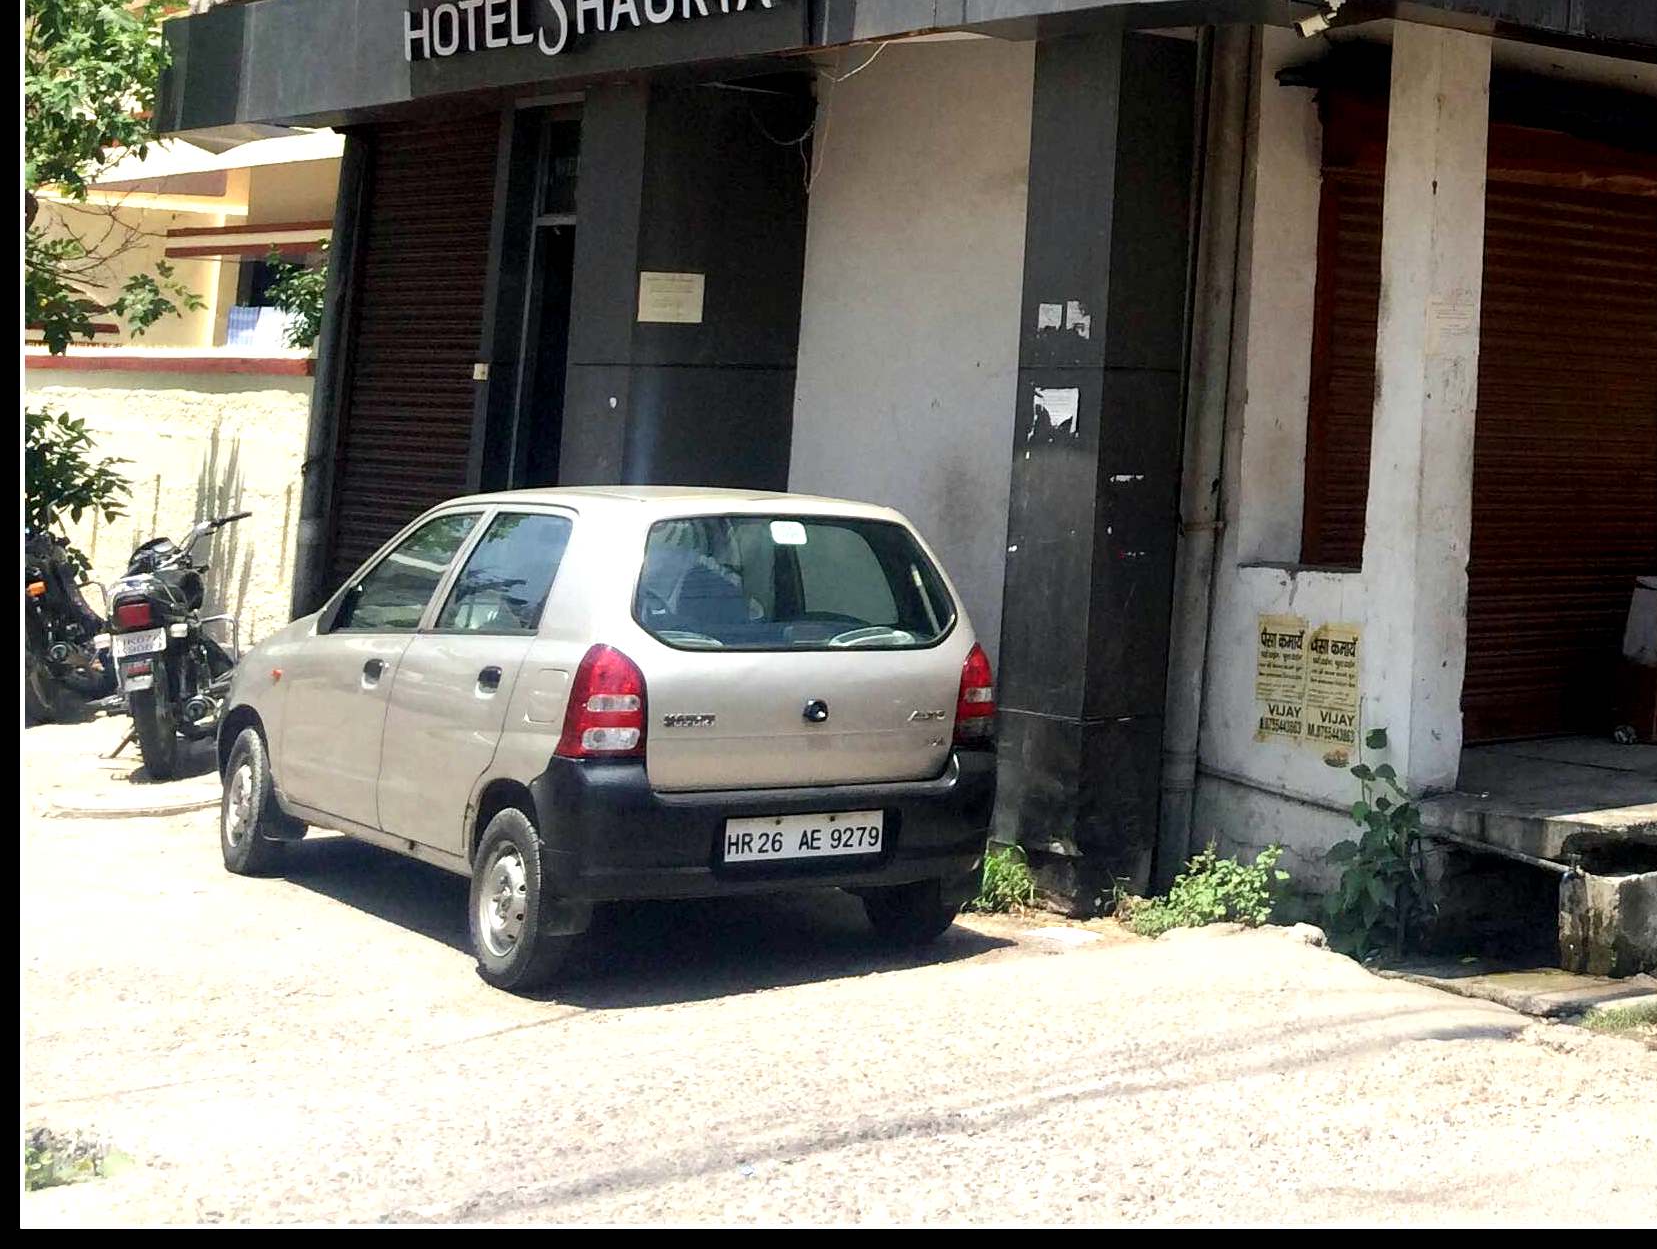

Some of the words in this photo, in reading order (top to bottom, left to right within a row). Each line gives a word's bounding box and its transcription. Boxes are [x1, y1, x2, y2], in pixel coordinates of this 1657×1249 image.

[1268, 704, 1301, 718] VIJAY
[1320, 710, 1355, 726] VIJAY
[799, 829, 821, 850] AE
[830, 825, 879, 849] 9279
